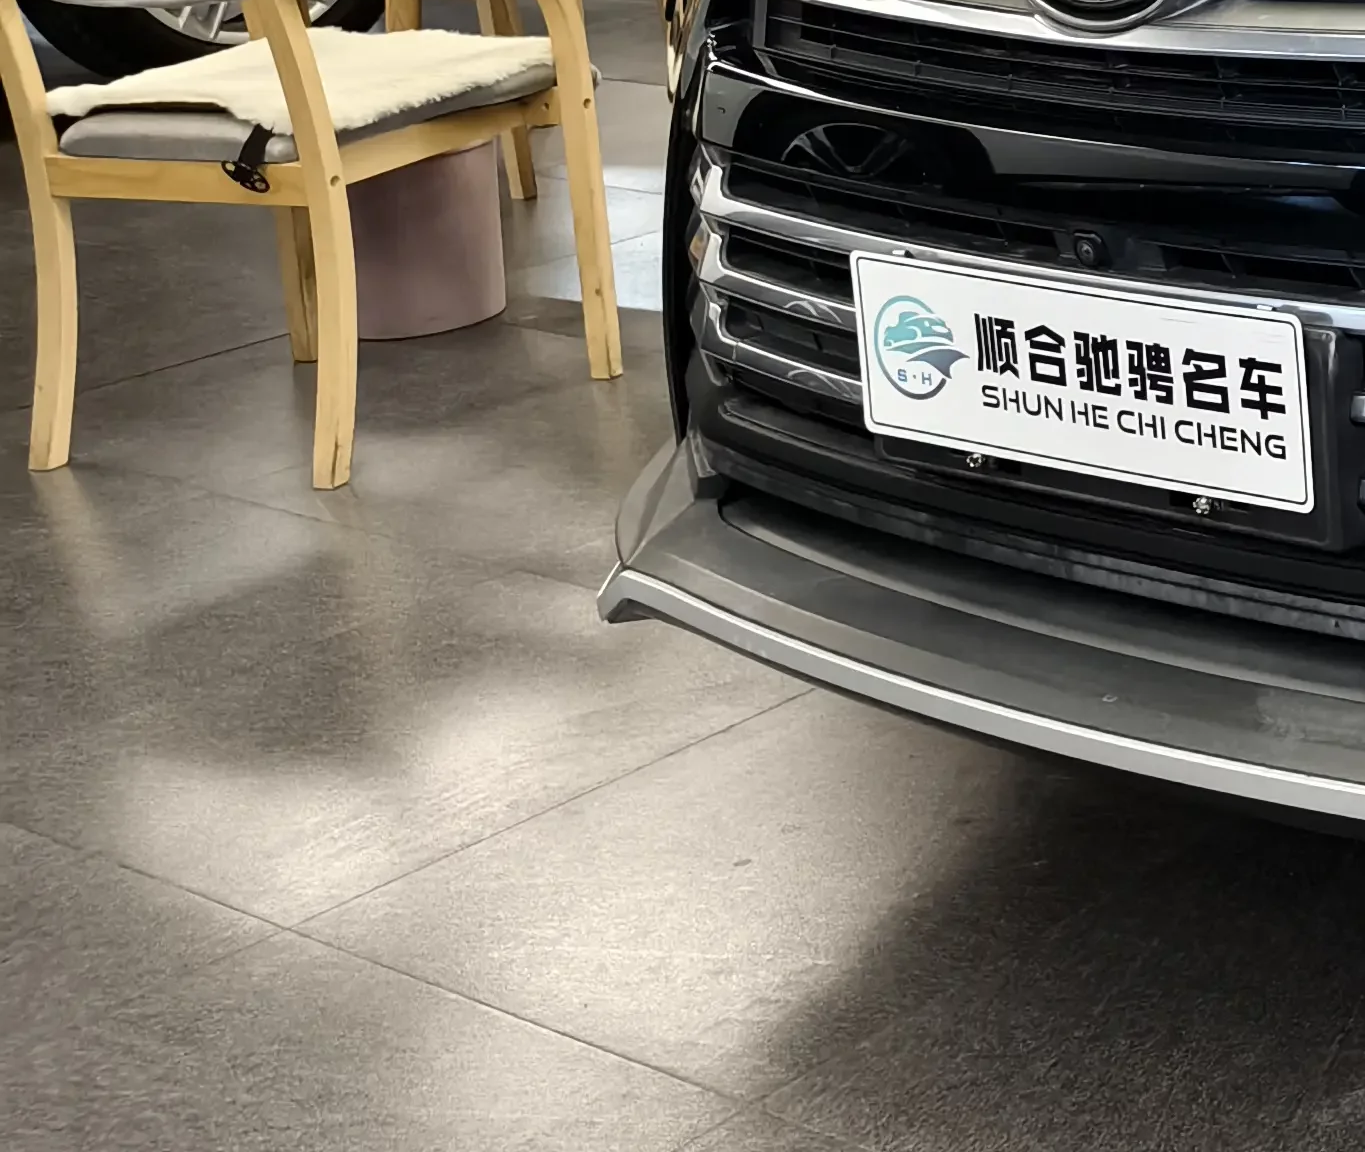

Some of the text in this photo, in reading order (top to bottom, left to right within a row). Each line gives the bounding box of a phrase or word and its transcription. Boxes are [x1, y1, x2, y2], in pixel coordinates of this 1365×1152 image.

[973, 313, 1286, 420] 顺合驰骋名车
[982, 385, 1287, 460] SHUN HE CHI CHENG
